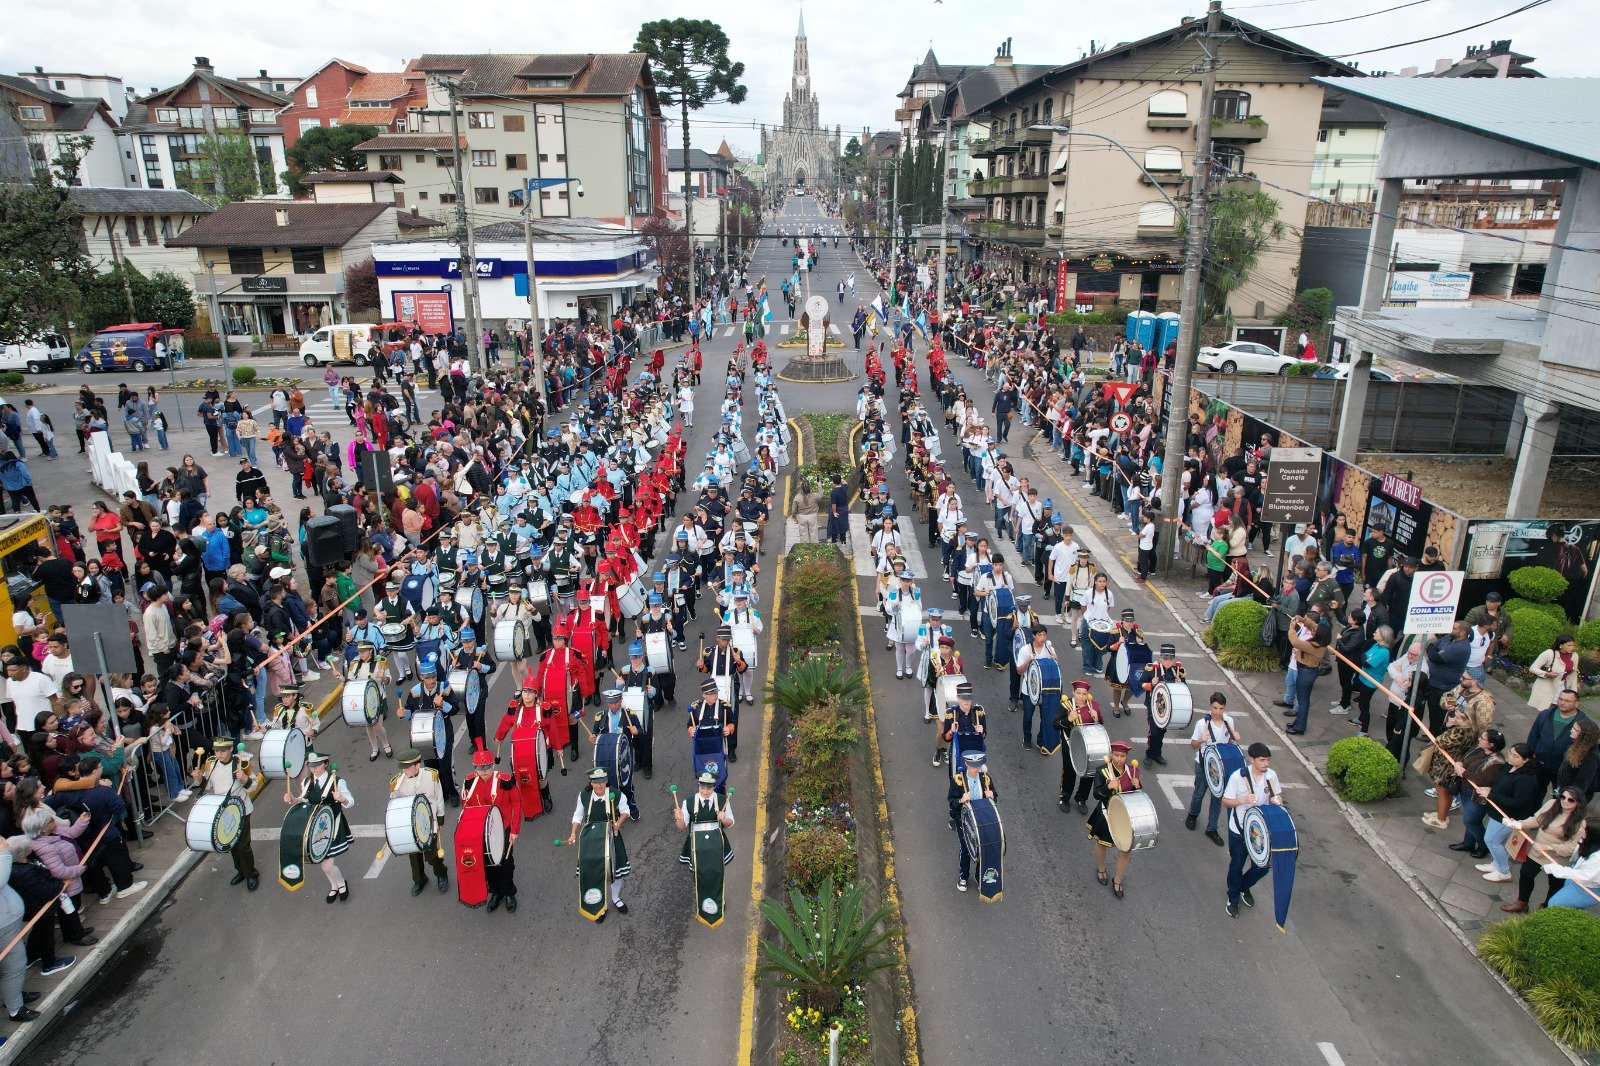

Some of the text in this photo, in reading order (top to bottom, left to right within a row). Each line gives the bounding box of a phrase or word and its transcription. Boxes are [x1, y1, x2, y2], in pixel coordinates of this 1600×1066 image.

[1383, 474, 1420, 506] EM BREVE
[1429, 579, 1445, 598] E
